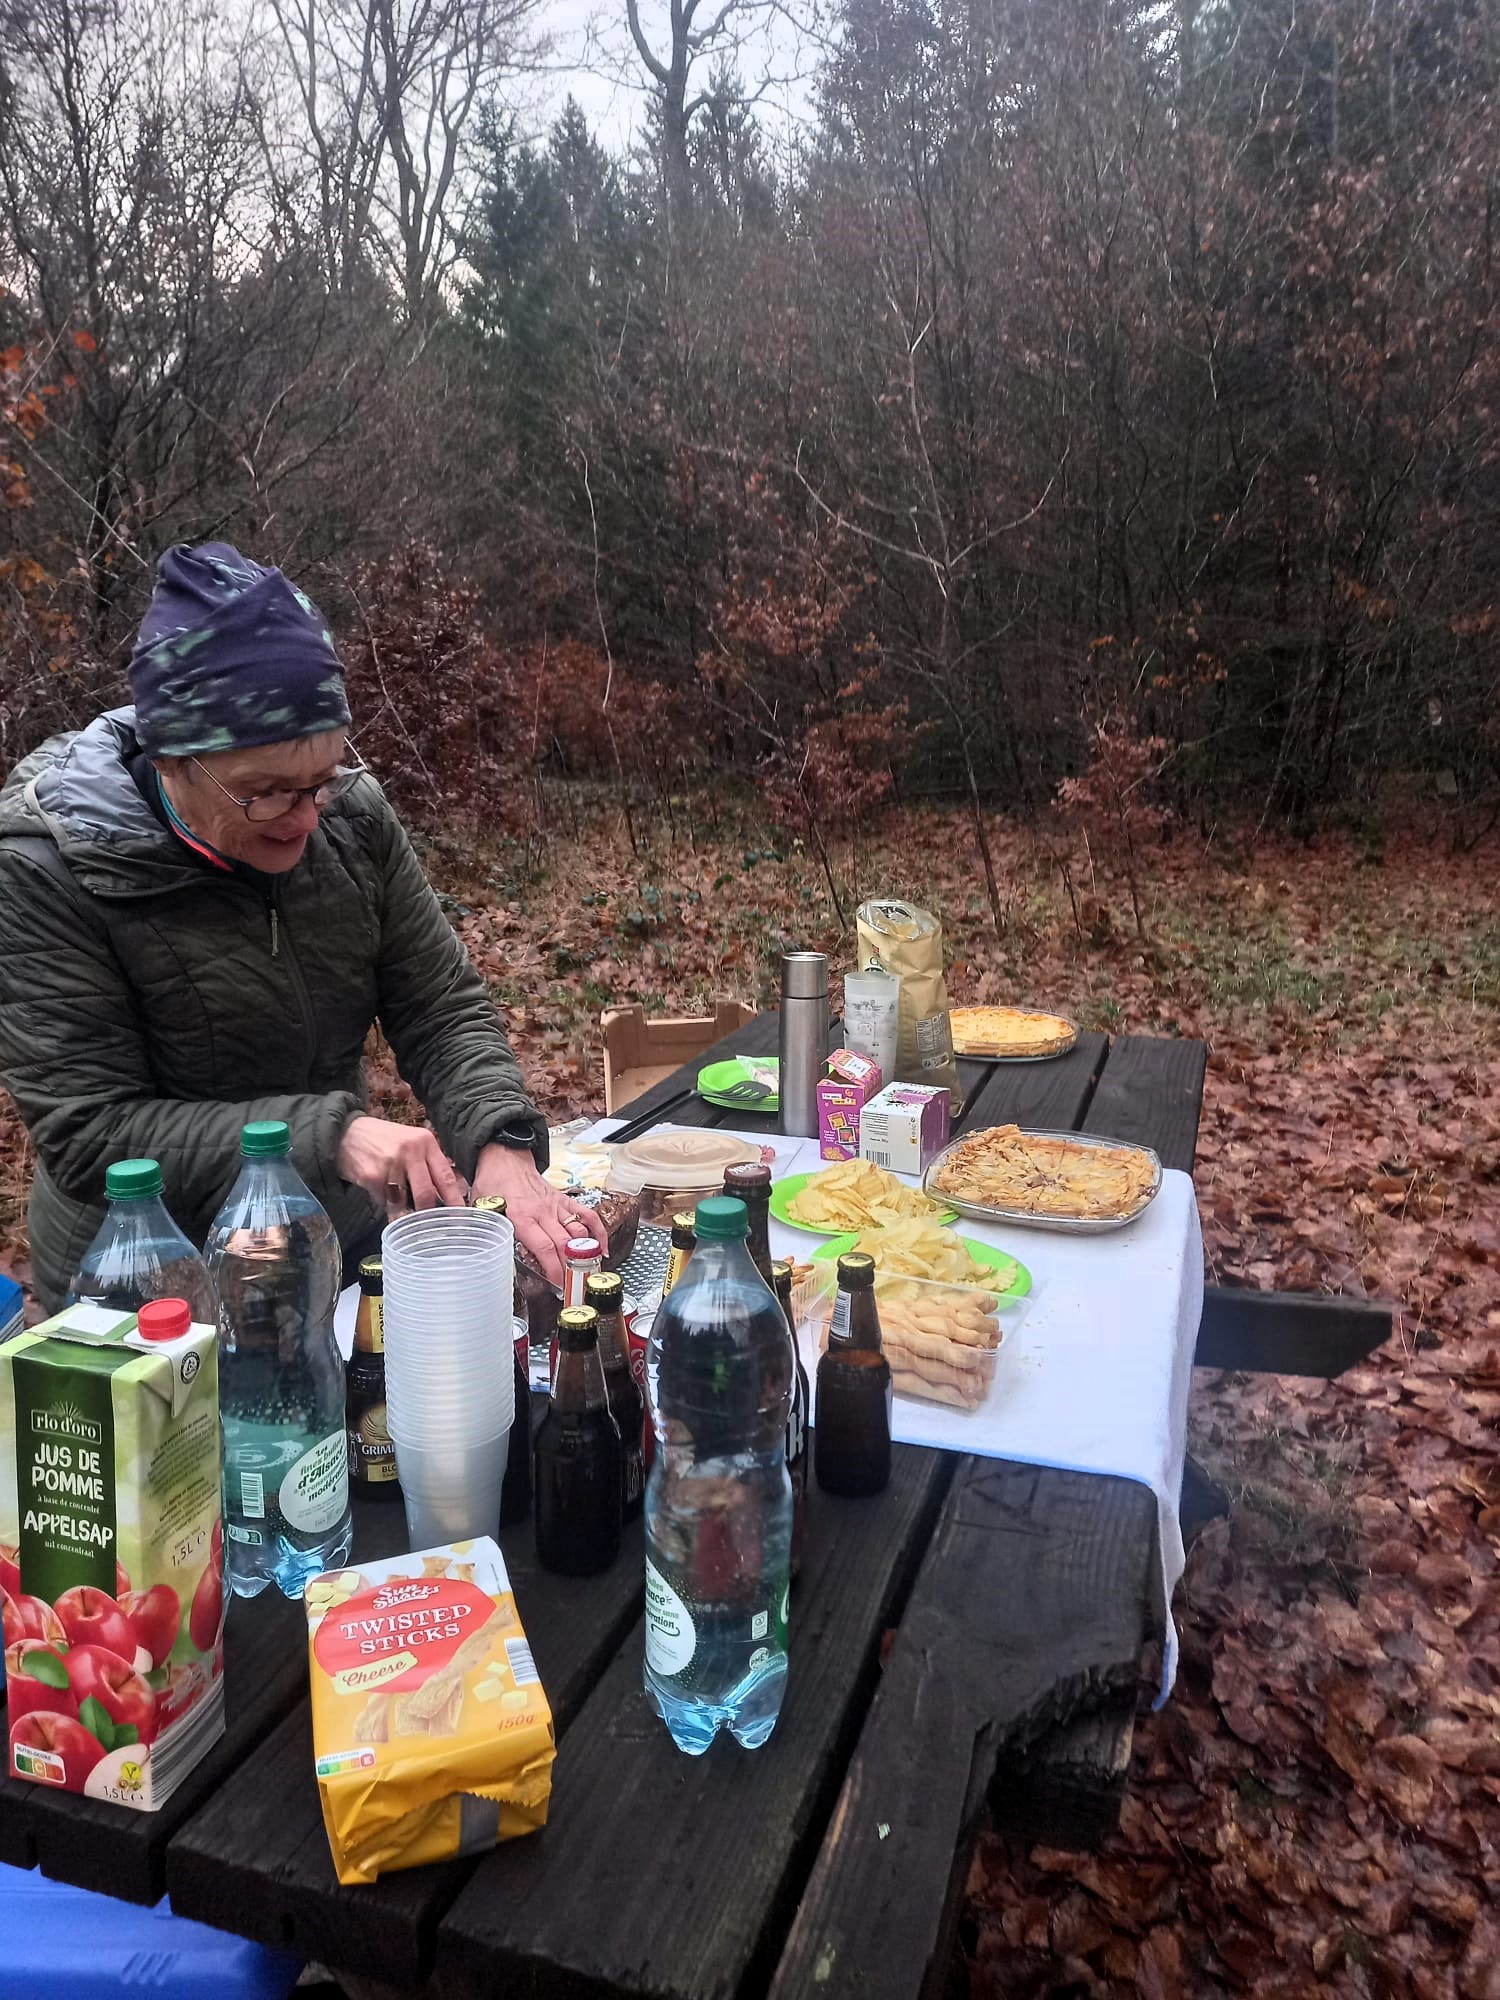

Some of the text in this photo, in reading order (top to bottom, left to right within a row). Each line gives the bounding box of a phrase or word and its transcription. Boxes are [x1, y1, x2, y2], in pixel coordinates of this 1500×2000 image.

[666, 1254, 676, 1290] BLONDE
[36, 1412, 96, 1439] rio d'oro
[34, 1442, 101, 1474] JUS DE
[31, 1466, 105, 1501] POMME
[43, 1495, 59, 1505] base
[59, 1497, 68, 1507] de
[69, 1500, 100, 1515] concentré
[23, 1509, 114, 1549] APPELSAP
[44, 1538, 95, 1559] uit concentraat
[373, 1585, 440, 1610] Snacks
[377, 1584, 421, 1599] Sun
[339, 1603, 472, 1640] TWISTED
[360, 1622, 460, 1654] STICKS
[342, 1660, 407, 1687] Cheese
[497, 1714, 535, 1730] 150g
